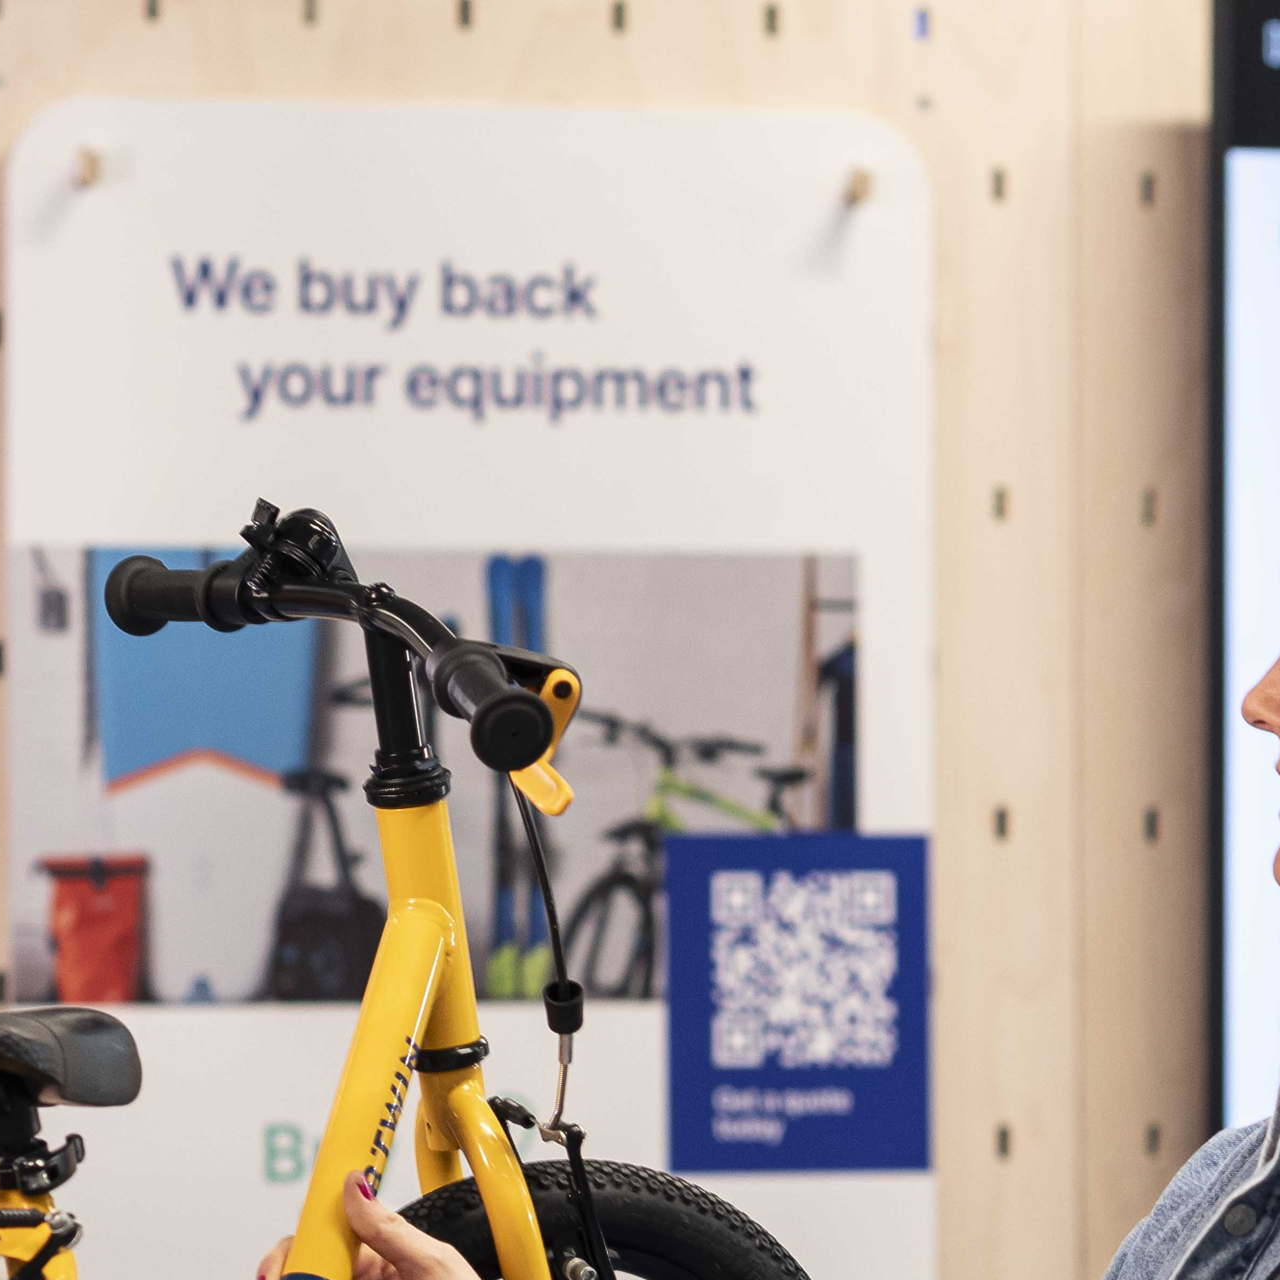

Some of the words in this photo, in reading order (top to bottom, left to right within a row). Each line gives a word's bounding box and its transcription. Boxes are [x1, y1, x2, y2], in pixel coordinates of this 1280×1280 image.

[171, 256, 277, 313] We
[296, 259, 420, 331] buy
[439, 262, 597, 319] back
[238, 361, 384, 421] your
[404, 354, 755, 424] equipment
